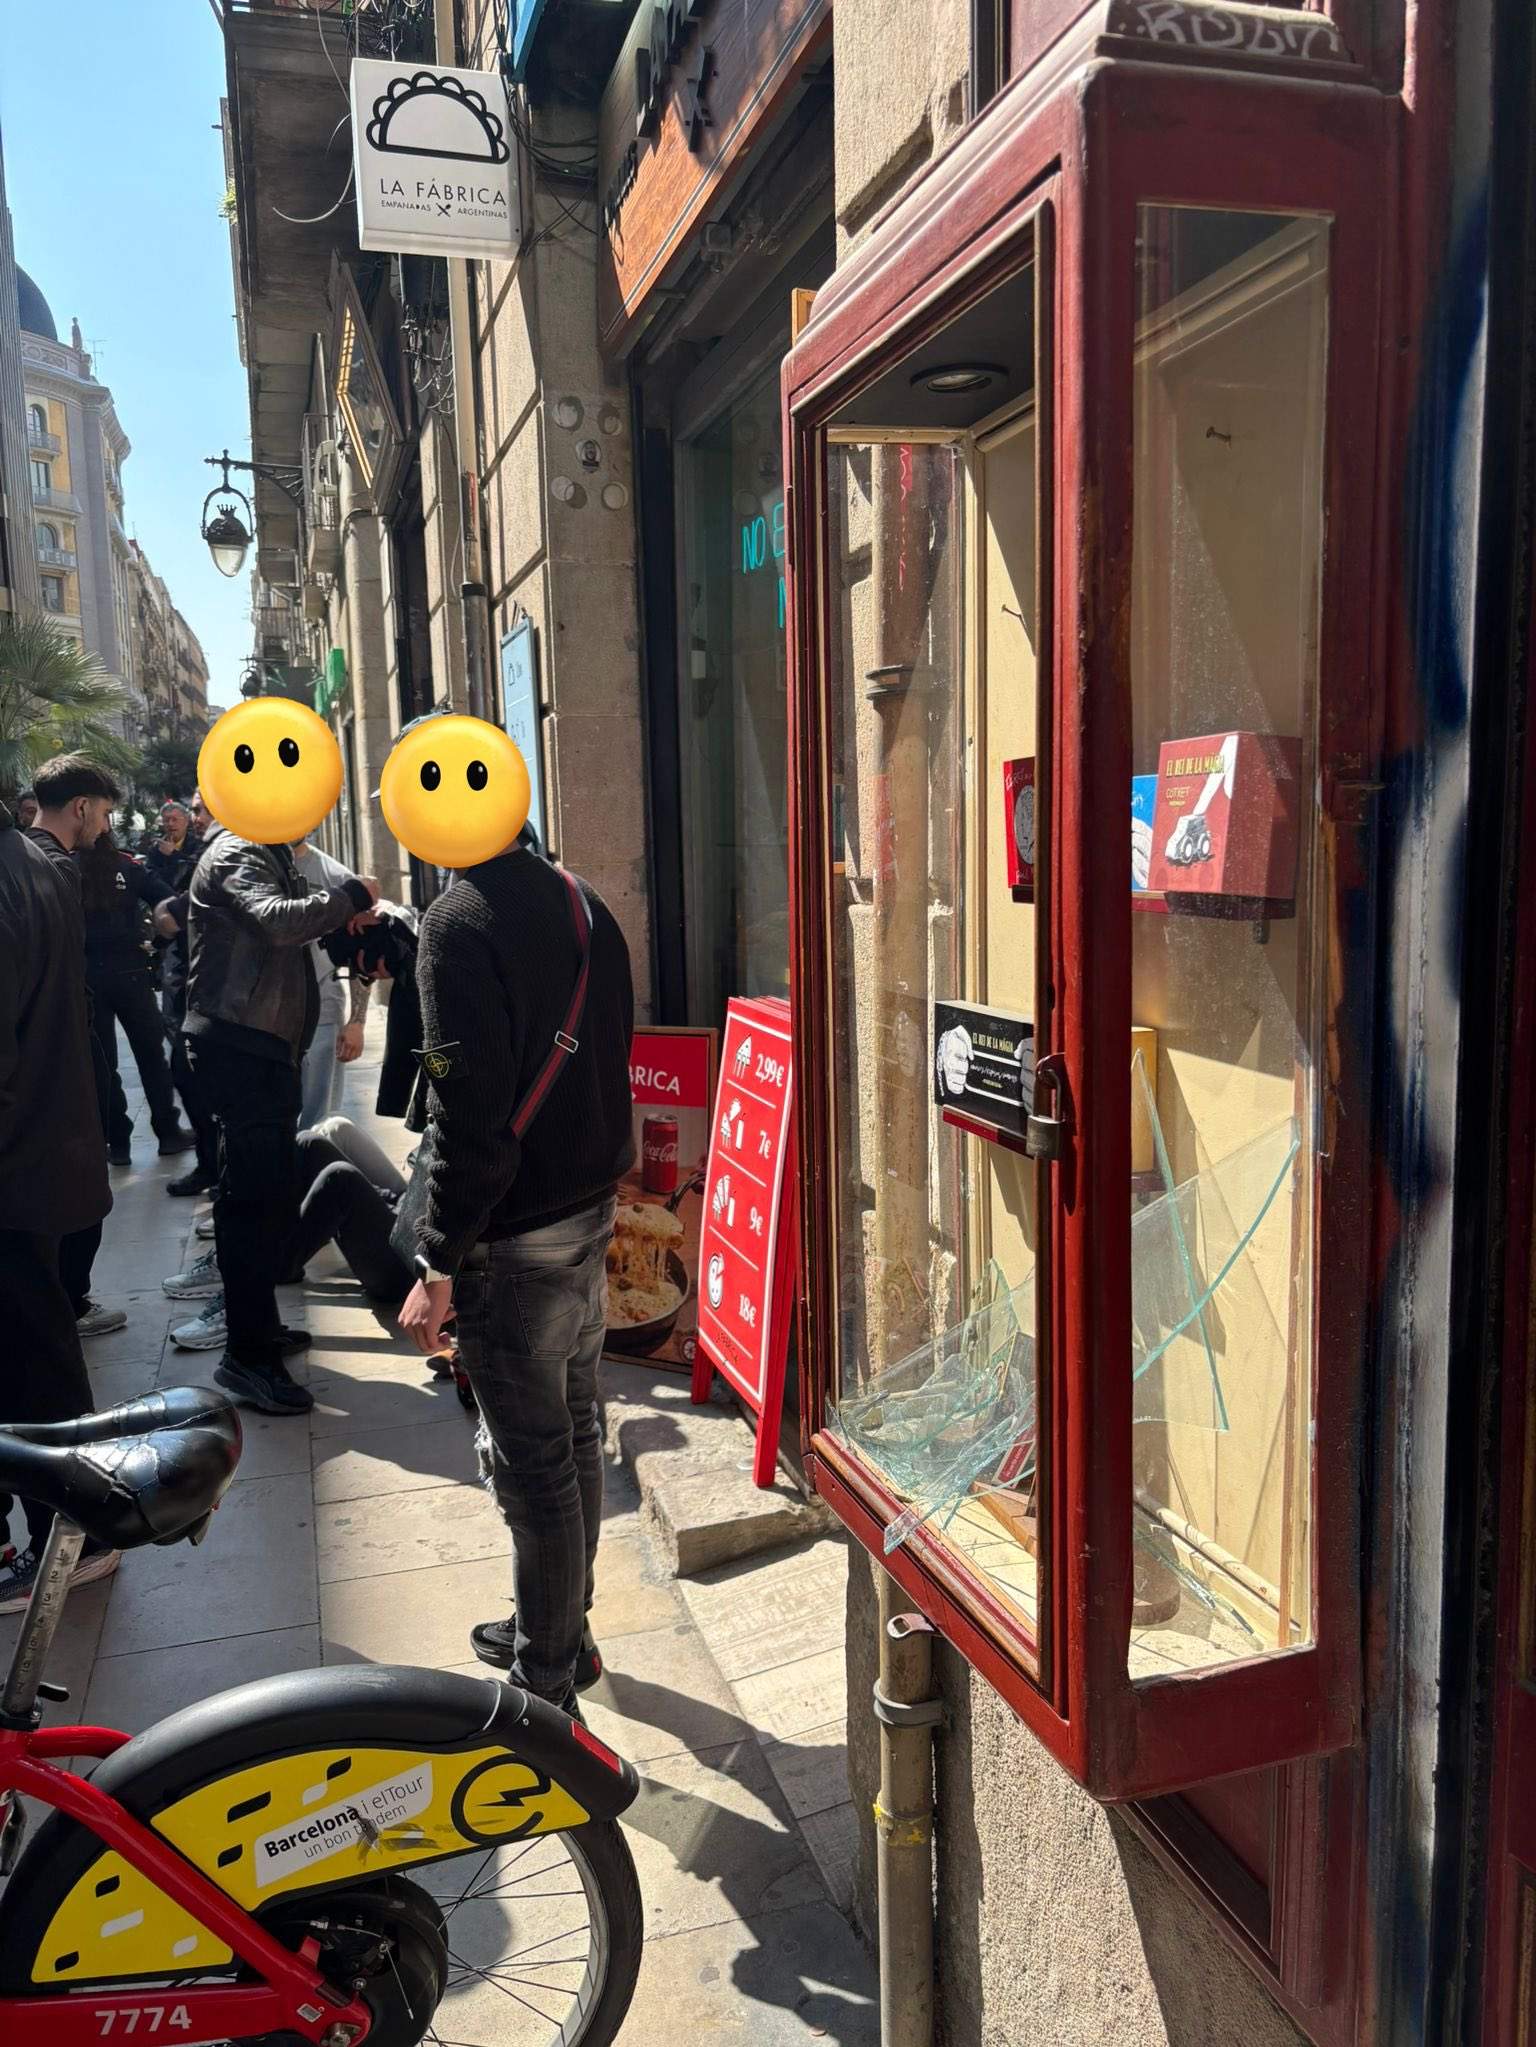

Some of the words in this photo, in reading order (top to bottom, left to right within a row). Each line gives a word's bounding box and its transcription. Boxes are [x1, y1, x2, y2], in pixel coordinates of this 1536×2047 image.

[380, 178, 405, 196] LA
[416, 178, 507, 206] FÁBRICA
[457, 207, 508, 219] ARGENTINAS
[742, 516, 766, 575] NO
[755, 1053, 785, 1088] 2,99€
[758, 1129, 772, 1159] 7€
[749, 1206, 764, 1237] 9€
[738, 1293, 757, 1329] 18€
[304, 1843, 323, 1858] un
[324, 1830, 352, 1849] bon
[95, 2005, 192, 2036] 7774
